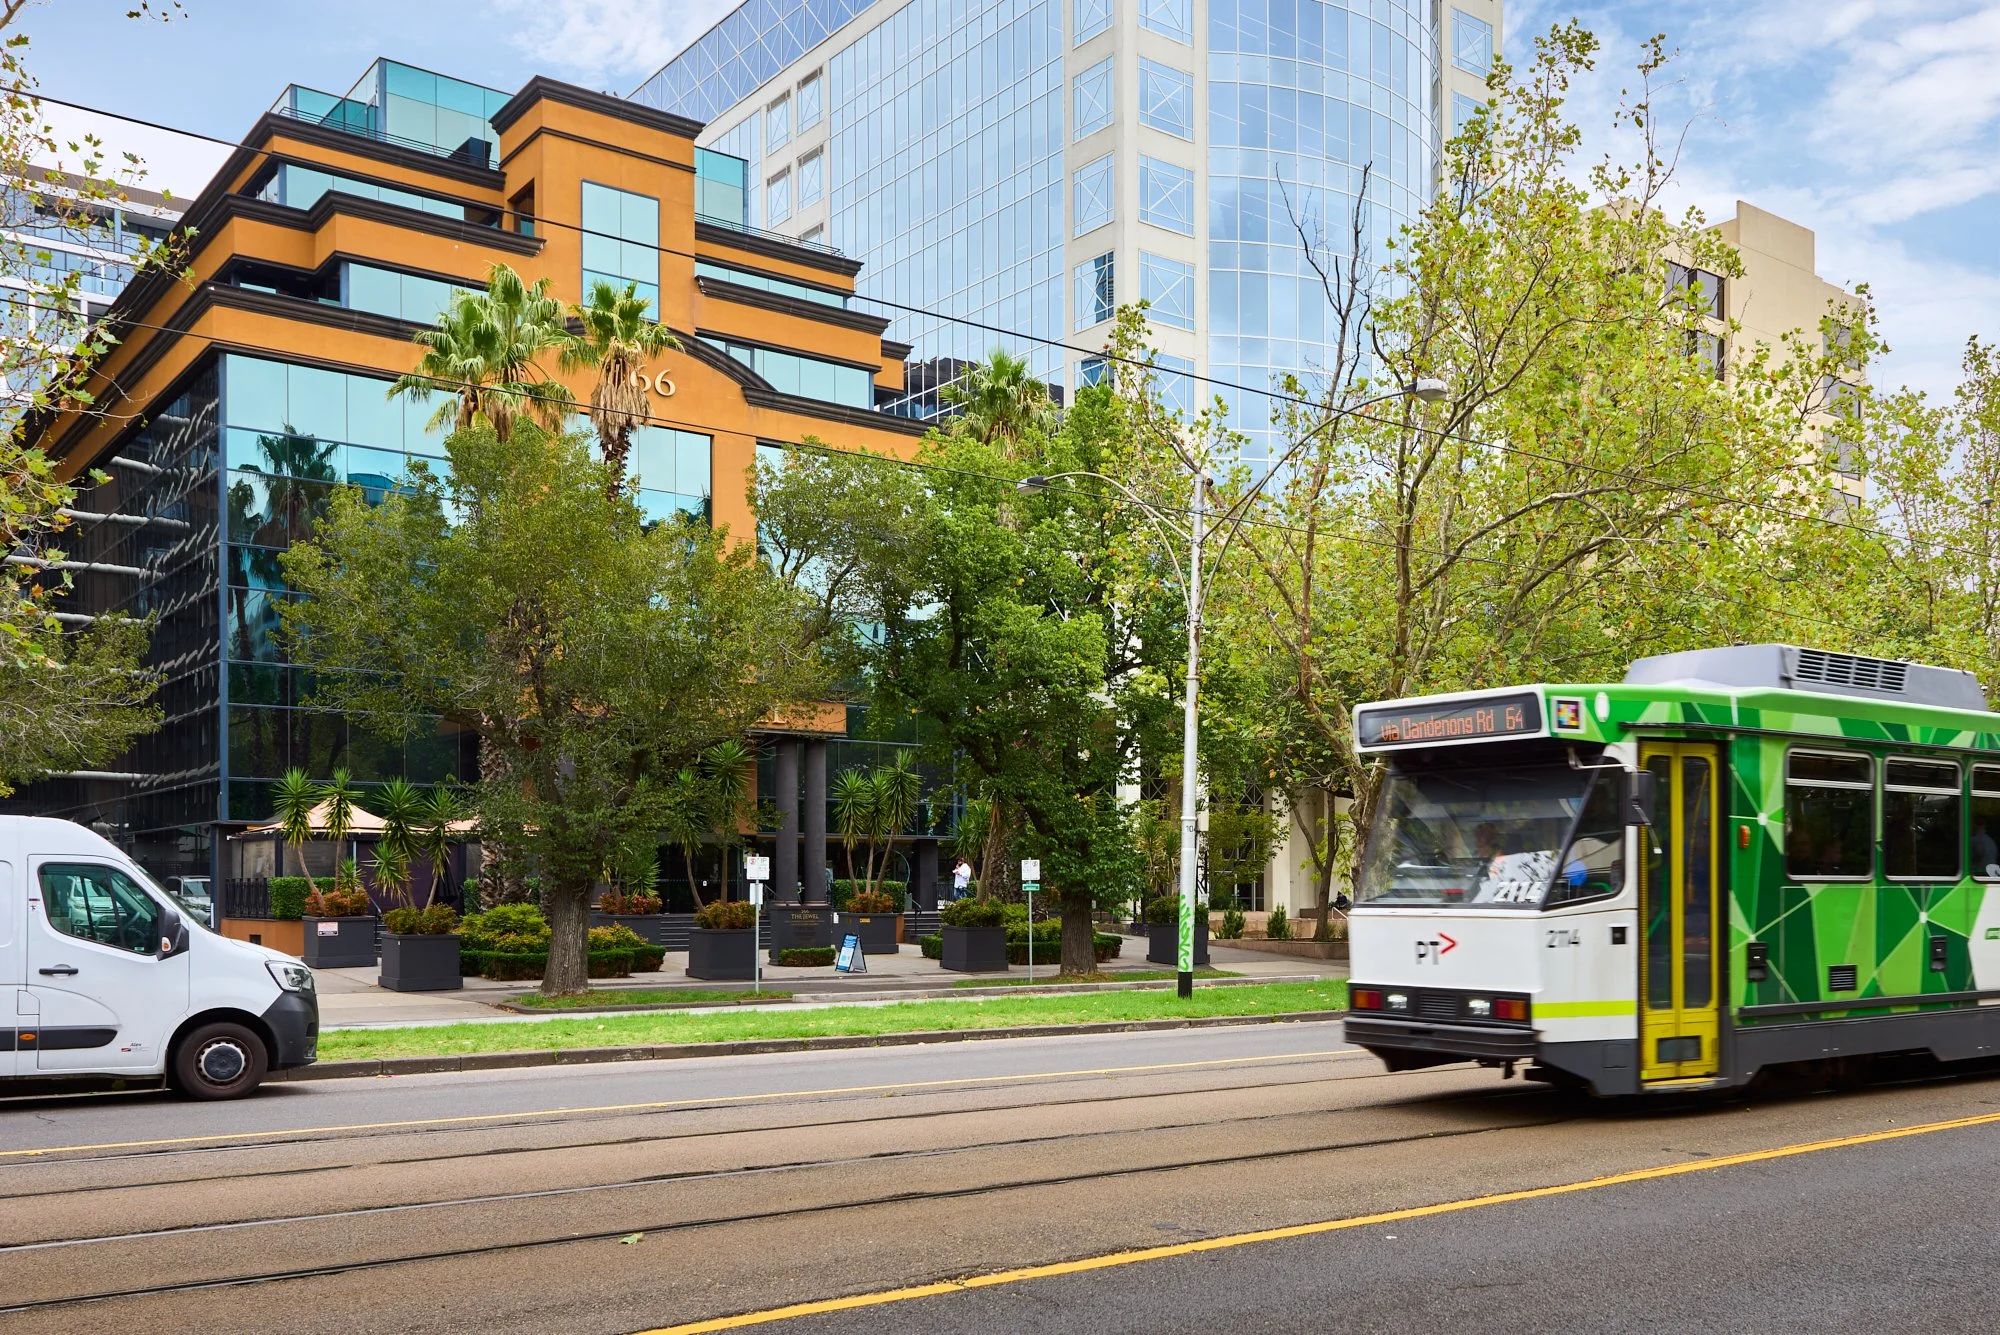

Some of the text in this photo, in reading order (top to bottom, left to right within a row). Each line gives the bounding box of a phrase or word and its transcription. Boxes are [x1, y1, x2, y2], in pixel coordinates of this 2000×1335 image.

[1381, 720, 1400, 742] via
[1476, 709, 1494, 733] Rd
[1505, 706, 1524, 731] 64
